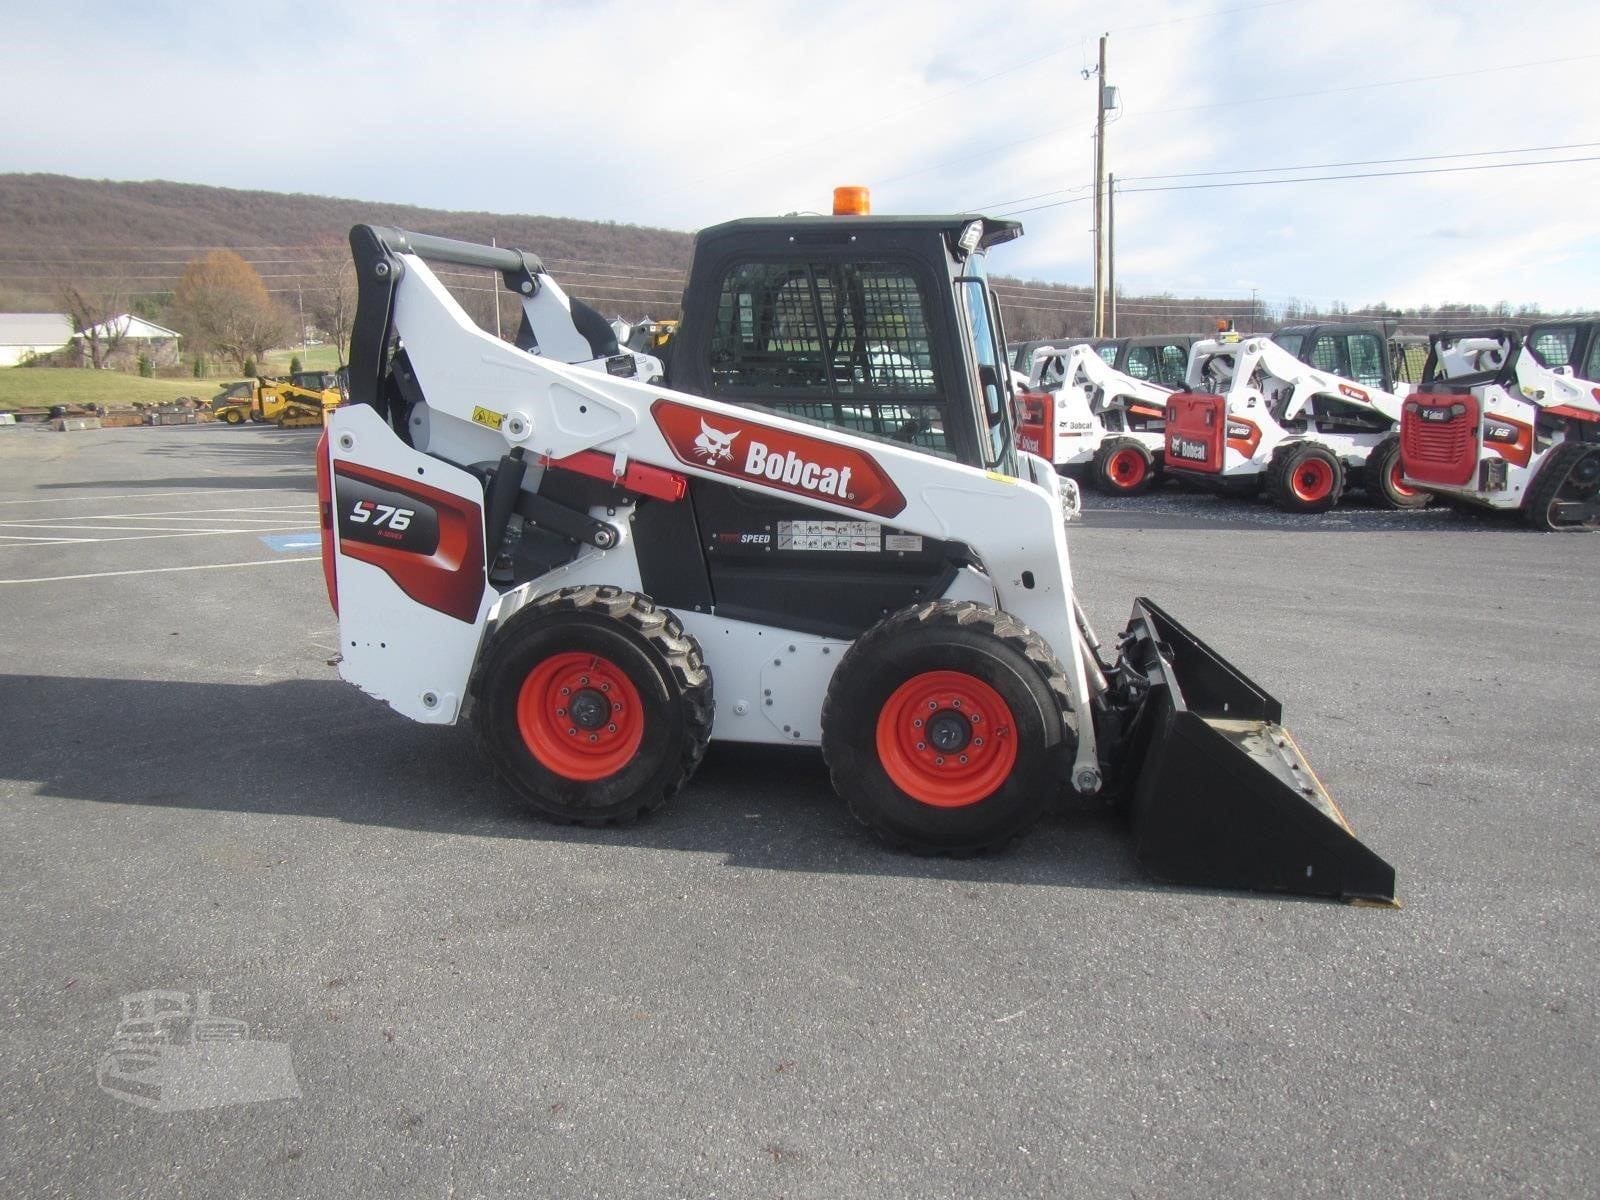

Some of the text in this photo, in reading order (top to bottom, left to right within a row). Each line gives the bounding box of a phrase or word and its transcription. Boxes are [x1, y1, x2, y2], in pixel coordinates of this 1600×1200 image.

[1246, 396, 1257, 409] 2
[1069, 420, 1093, 430] Bobcat
[1182, 441, 1206, 460] Bobcat
[744, 441, 852, 498] Bobcat
[350, 501, 415, 530] S76
[740, 534, 771, 543] SPEED
